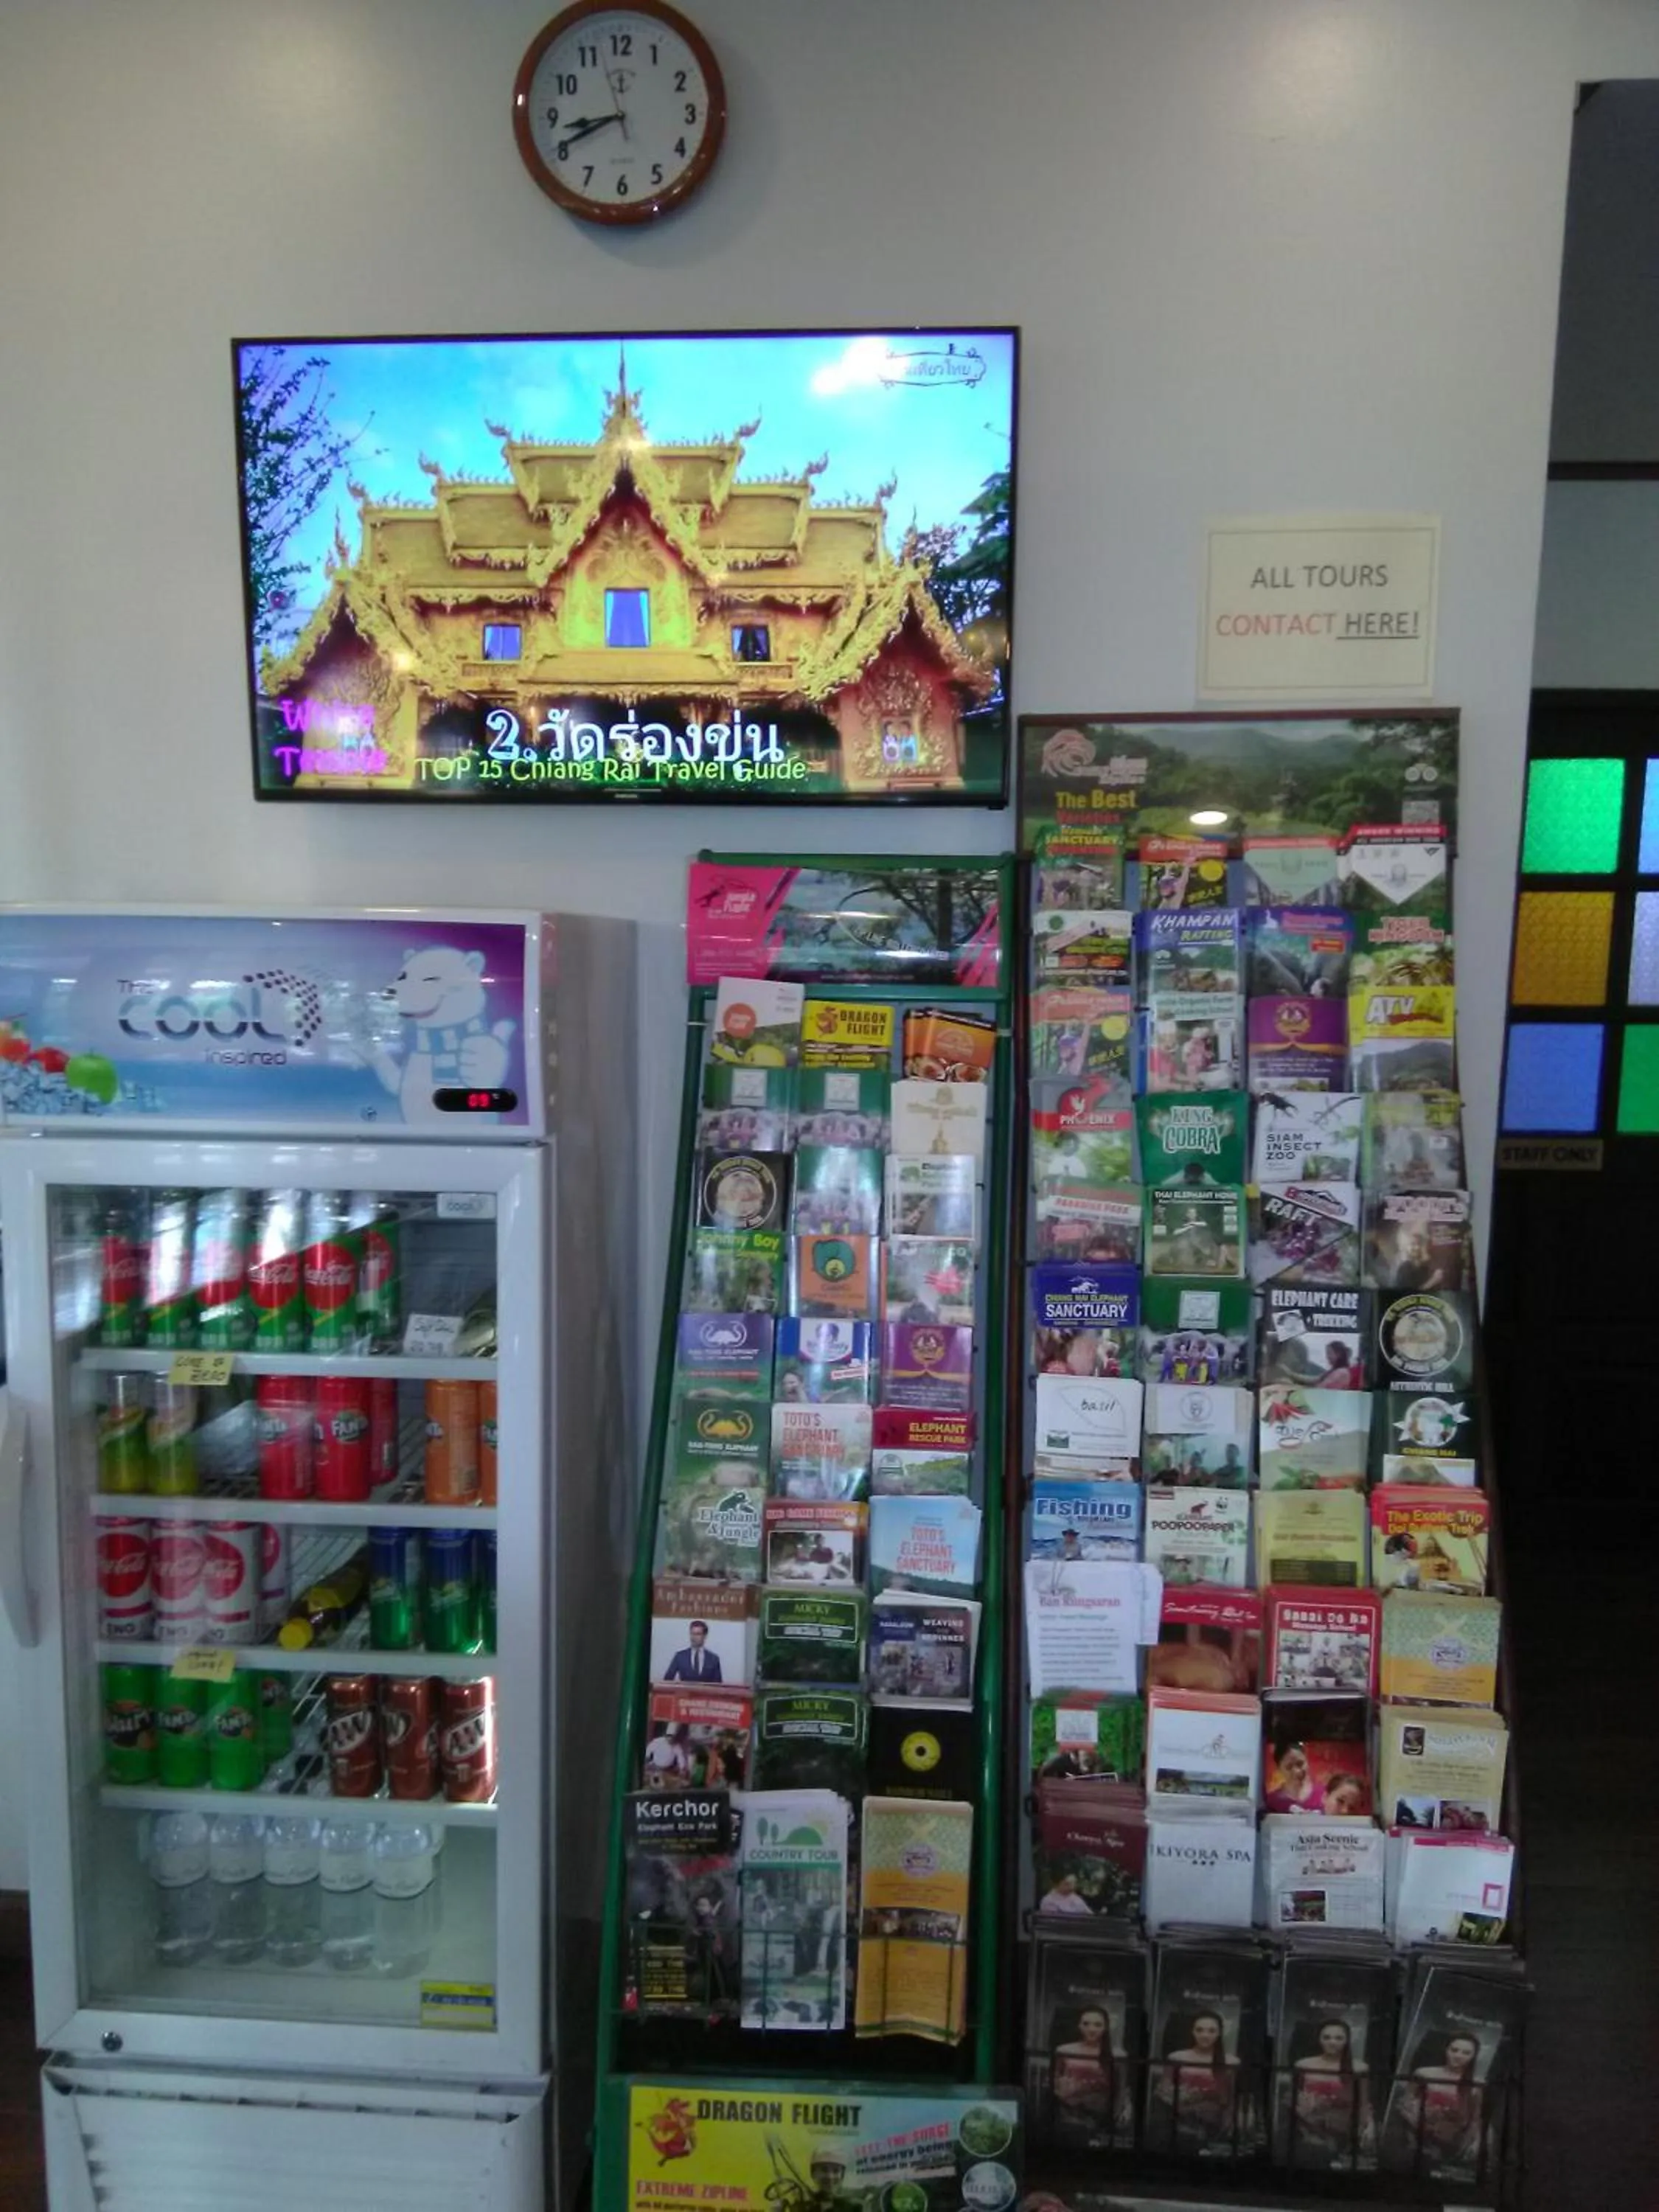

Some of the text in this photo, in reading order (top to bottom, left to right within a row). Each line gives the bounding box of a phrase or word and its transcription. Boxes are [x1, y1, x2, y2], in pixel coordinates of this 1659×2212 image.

[610, 35, 631, 56] 12
[650, 44, 658, 64] 1
[579, 46, 597, 67] 11
[556, 74, 577, 94] 10
[675, 72, 686, 92] 2
[547, 107, 558, 128] 9
[685, 104, 696, 125] 3
[558, 141, 568, 161] 8
[675, 137, 686, 158] 4
[582, 166, 594, 186] 7
[651, 164, 663, 184] 5
[617, 175, 627, 195] 6
[1251, 565, 1389, 588] ALL TOURS
[1217, 611, 1419, 636] CONTACT HERE!
[414, 757, 807, 782] TOP 15 Chiang Rai Travel Guide
[1056, 789, 1137, 809] The Best
[1152, 914, 1234, 931] KHAMPAN
[840, 1009, 888, 1024] DRAGON
[1366, 995, 1416, 1023] ATV
[846, 1023, 886, 1037] FLIGHT
[1171, 1106, 1213, 1126] KING
[1164, 1125, 1221, 1154] COBRA
[1266, 1133, 1304, 1142] SIAM
[1267, 1142, 1322, 1151] INSECT
[1266, 1151, 1296, 1161] ZOO
[753, 1234, 780, 1251] Boy
[1271, 1290, 1359, 1309] ELEPHANT CARE
[1045, 1304, 1127, 1318] SANCTUARY
[783, 1412, 822, 1427] TOTO'S
[908, 1422, 967, 1434] ELEPHANT
[782, 1427, 841, 1443] ELEPHANT
[908, 1433, 967, 1444] RESCUE PARK
[698, 1506, 758, 1524] Elephant
[1036, 1498, 1133, 1520] Fishing
[1459, 1512, 1484, 1527] Trip
[900, 1540, 953, 1558] ELEPHANT
[896, 1556, 956, 1576] SANCTUARY
[635, 1798, 720, 1820] Kerchor
[749, 1848, 838, 1861] COUNTRY TOUR
[1156, 1845, 1252, 1863] KIYORA SPA
[697, 2098, 862, 2128] DRAGON FLIGHT
[636, 2179, 751, 2201] EXTREME ZIPLINE
